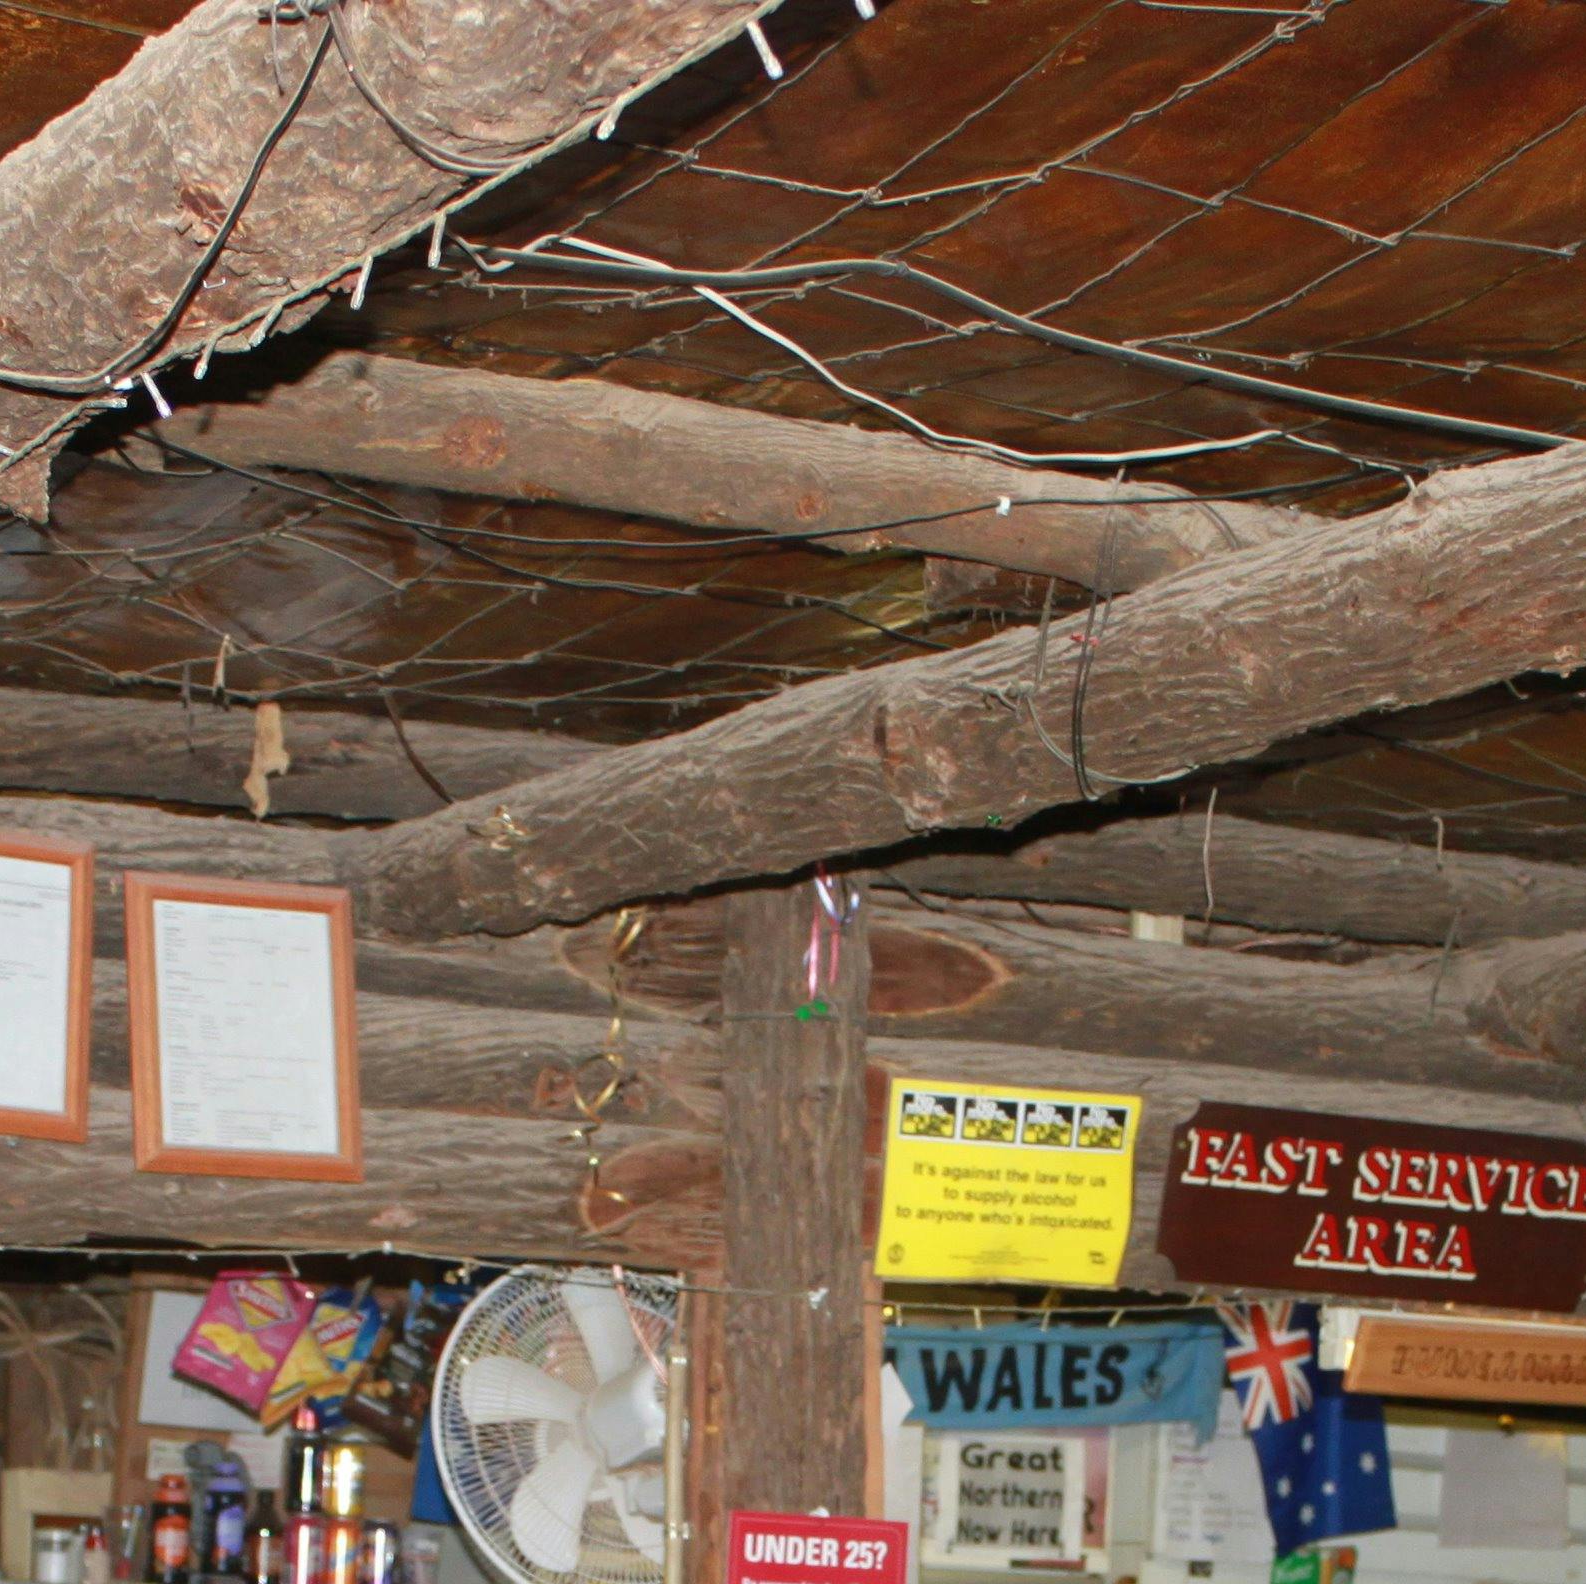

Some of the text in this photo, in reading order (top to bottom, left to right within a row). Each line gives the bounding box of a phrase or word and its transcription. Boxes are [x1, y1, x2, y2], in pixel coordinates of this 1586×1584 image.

[913, 1160, 1106, 1188] It's against the law for us
[1181, 1126, 1344, 1196] FAST
[943, 1187, 1077, 1207] to supply alcohol
[896, 1205, 1114, 1231] to anyone who's intoxicated.
[1293, 1212, 1478, 1281] AREA
[918, 1341, 1130, 1413] WALES
[960, 1442, 1063, 1472] Great
[960, 1482, 1063, 1508] Northern
[957, 1519, 1000, 1544] Now
[743, 1533, 889, 1570] UNDER 25?
